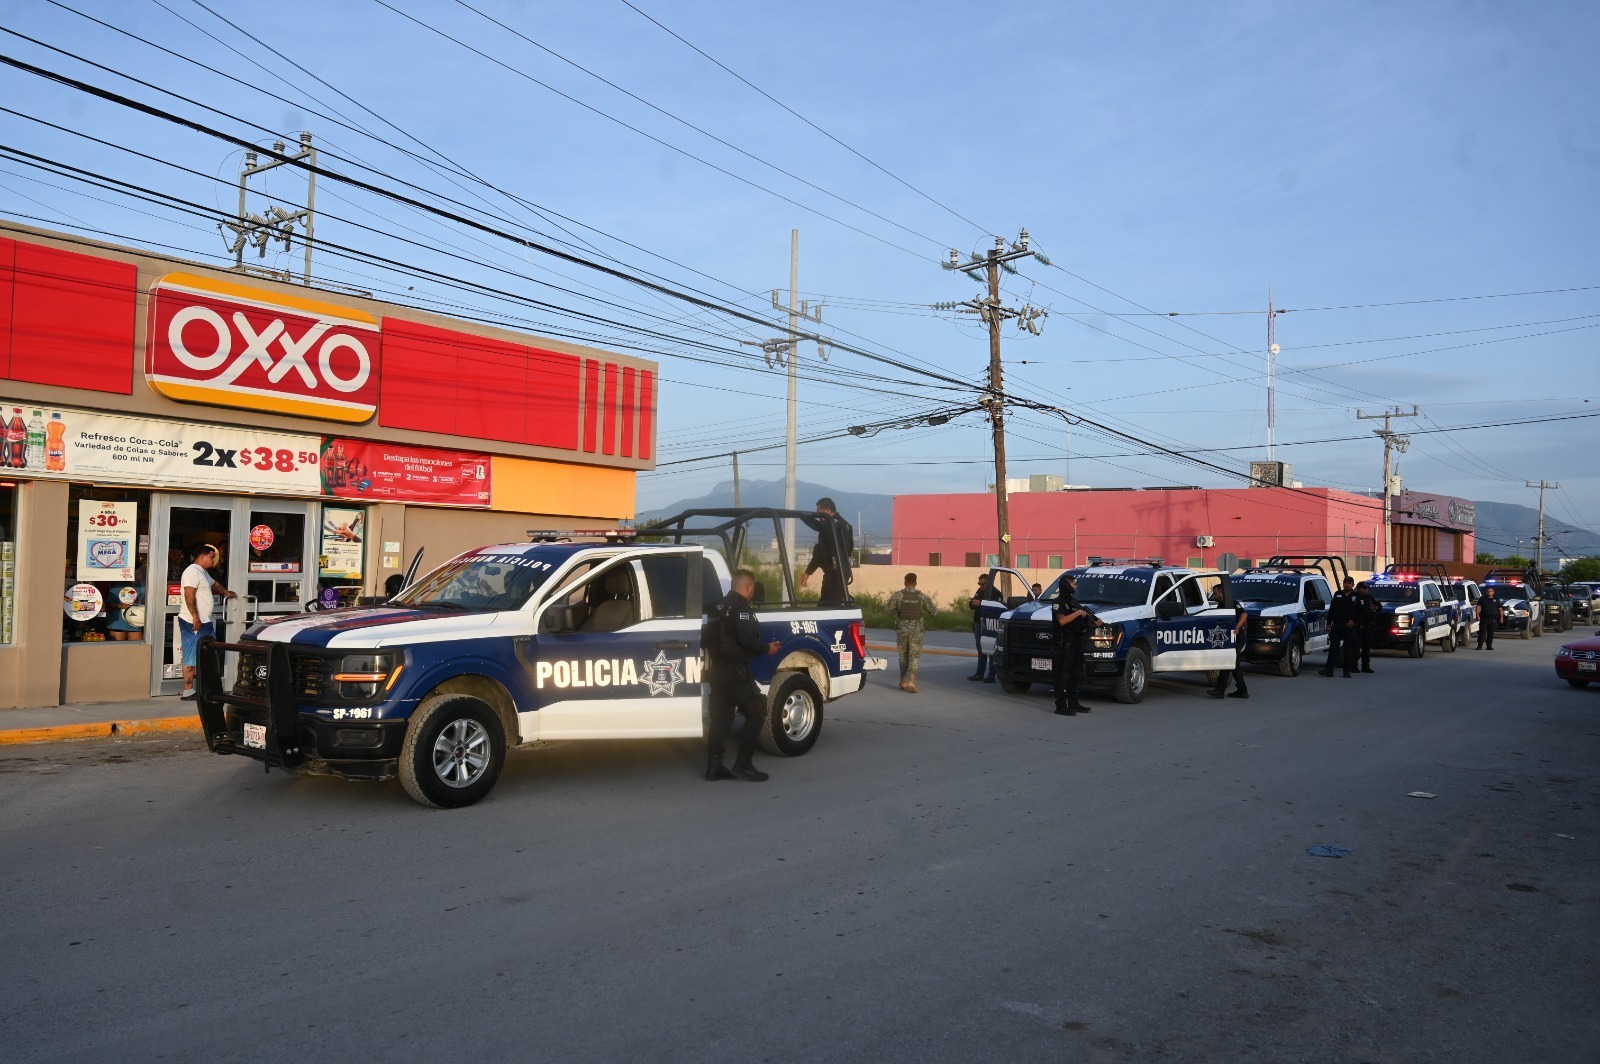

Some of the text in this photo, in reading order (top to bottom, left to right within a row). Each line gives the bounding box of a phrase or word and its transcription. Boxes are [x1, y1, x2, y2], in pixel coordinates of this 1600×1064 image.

[168, 305, 371, 393] OXXO
[80, 431, 126, 443] Refresco
[74, 441, 111, 451] Variedad
[113, 444, 124, 452] de
[126, 446, 149, 454] Colas
[158, 448, 188, 458] Sabores
[112, 453, 128, 461] 600
[130, 454, 140, 462] ml
[192, 440, 238, 469] 2x
[383, 453, 410, 463] Destapa
[410, 454, 418, 463] las
[418, 456, 453, 467] emociones
[89, 514, 118, 527] $30
[1156, 626, 1205, 645] POLICÍA
[536, 658, 639, 689] POLICIA
